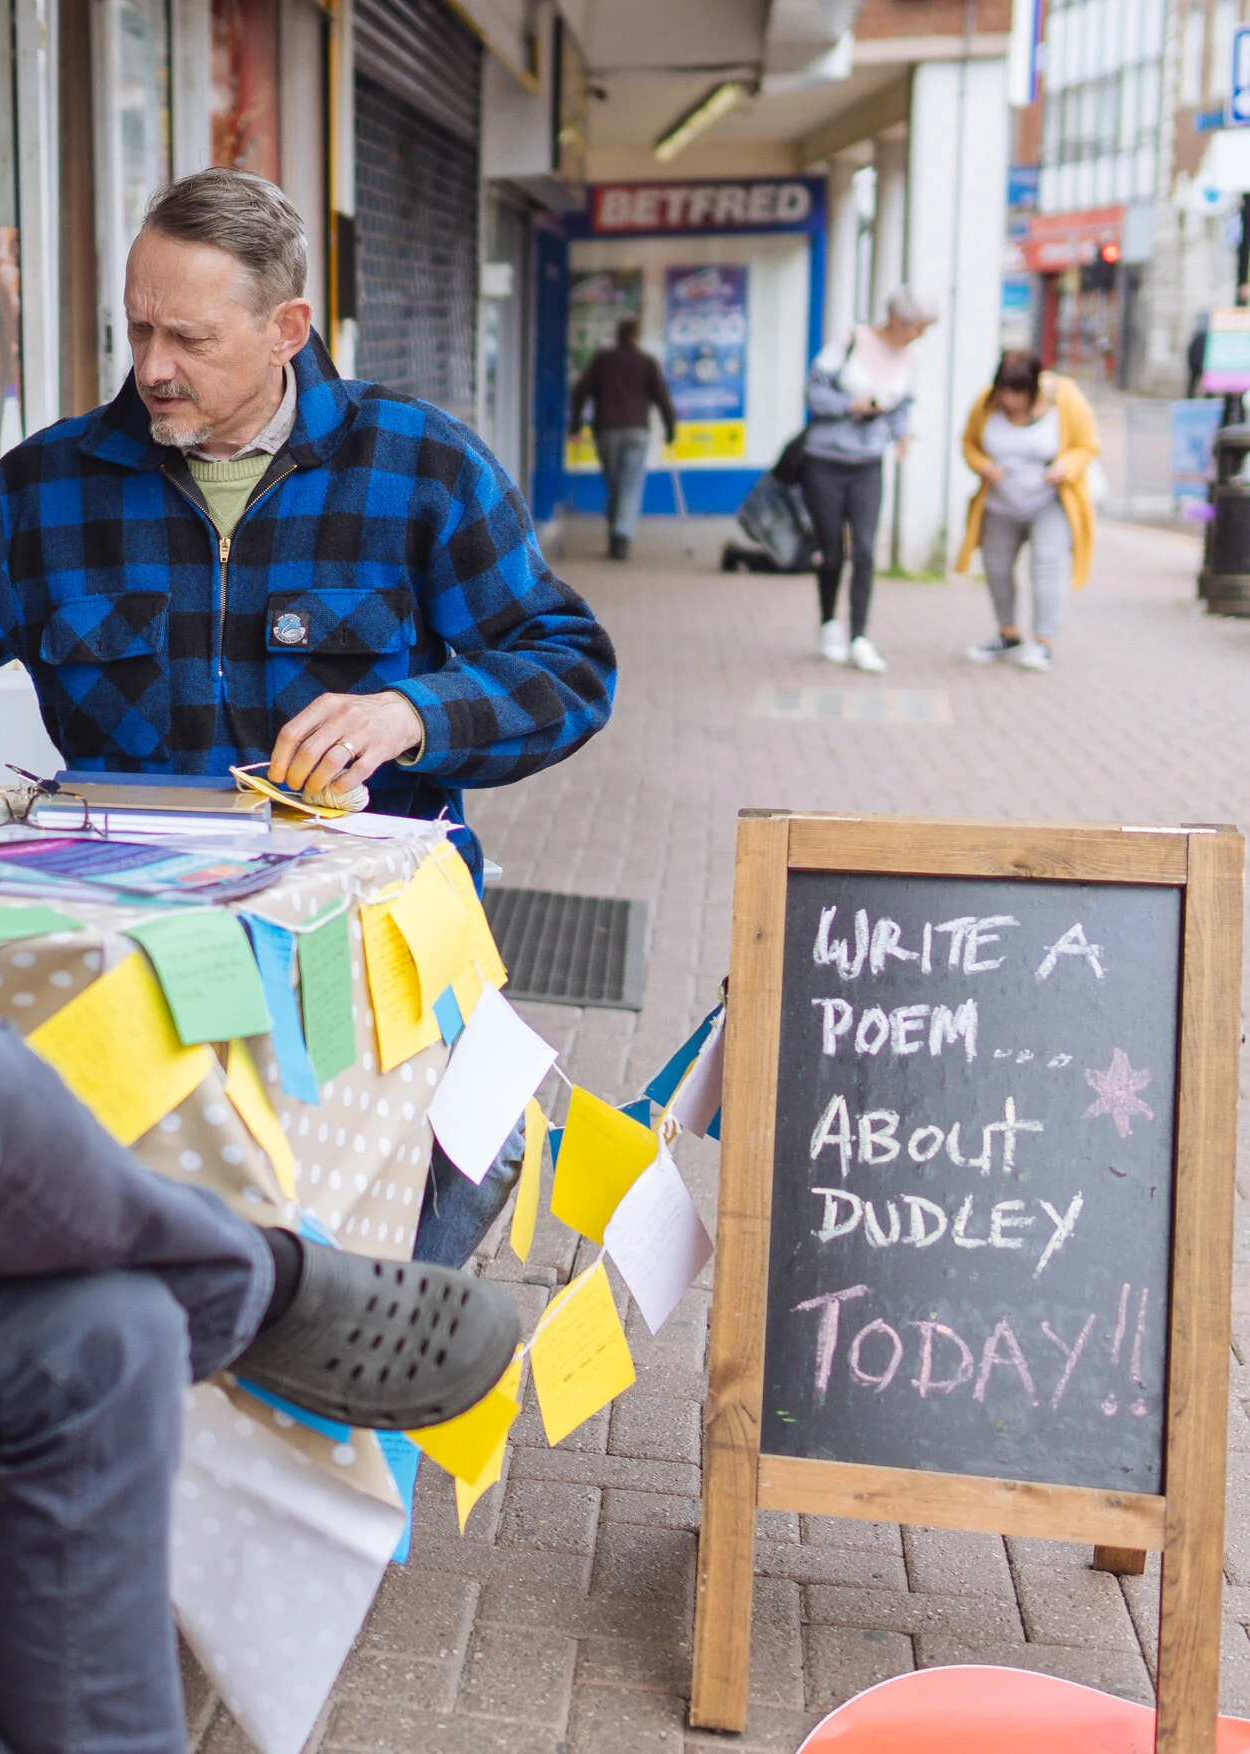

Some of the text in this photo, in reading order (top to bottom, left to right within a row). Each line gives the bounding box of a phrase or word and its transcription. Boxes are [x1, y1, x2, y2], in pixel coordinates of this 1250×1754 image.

[601, 182, 811, 227] BETFRED
[812, 905, 1108, 982] WRITE A
[810, 1187, 1084, 1279] DUDLEY
